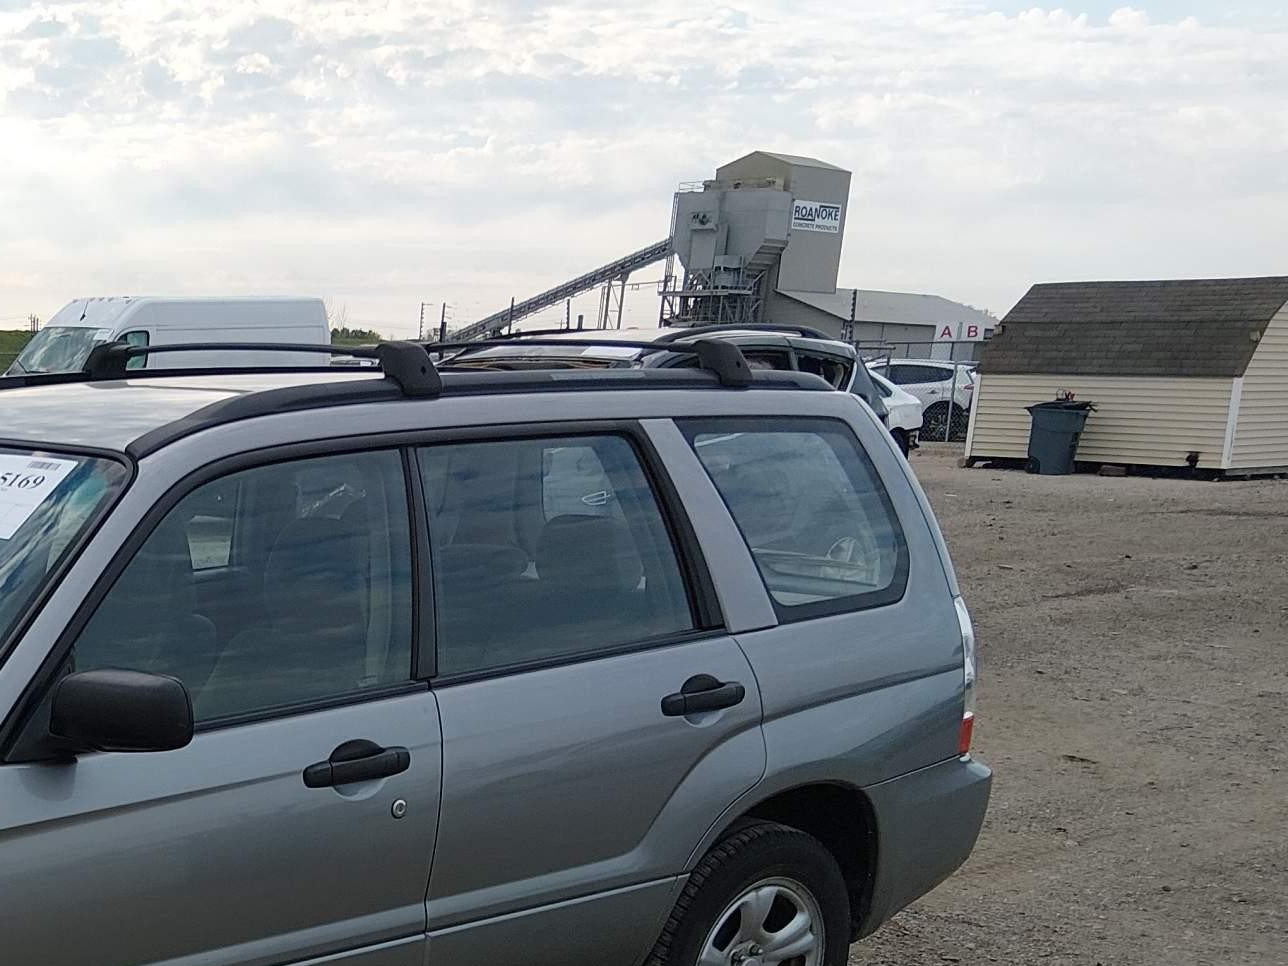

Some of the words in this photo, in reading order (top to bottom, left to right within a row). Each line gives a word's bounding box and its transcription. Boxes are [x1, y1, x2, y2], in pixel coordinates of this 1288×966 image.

[794, 205, 839, 221] ROANOKE
[940, 326, 952, 338] A
[967, 326, 978, 338] B
